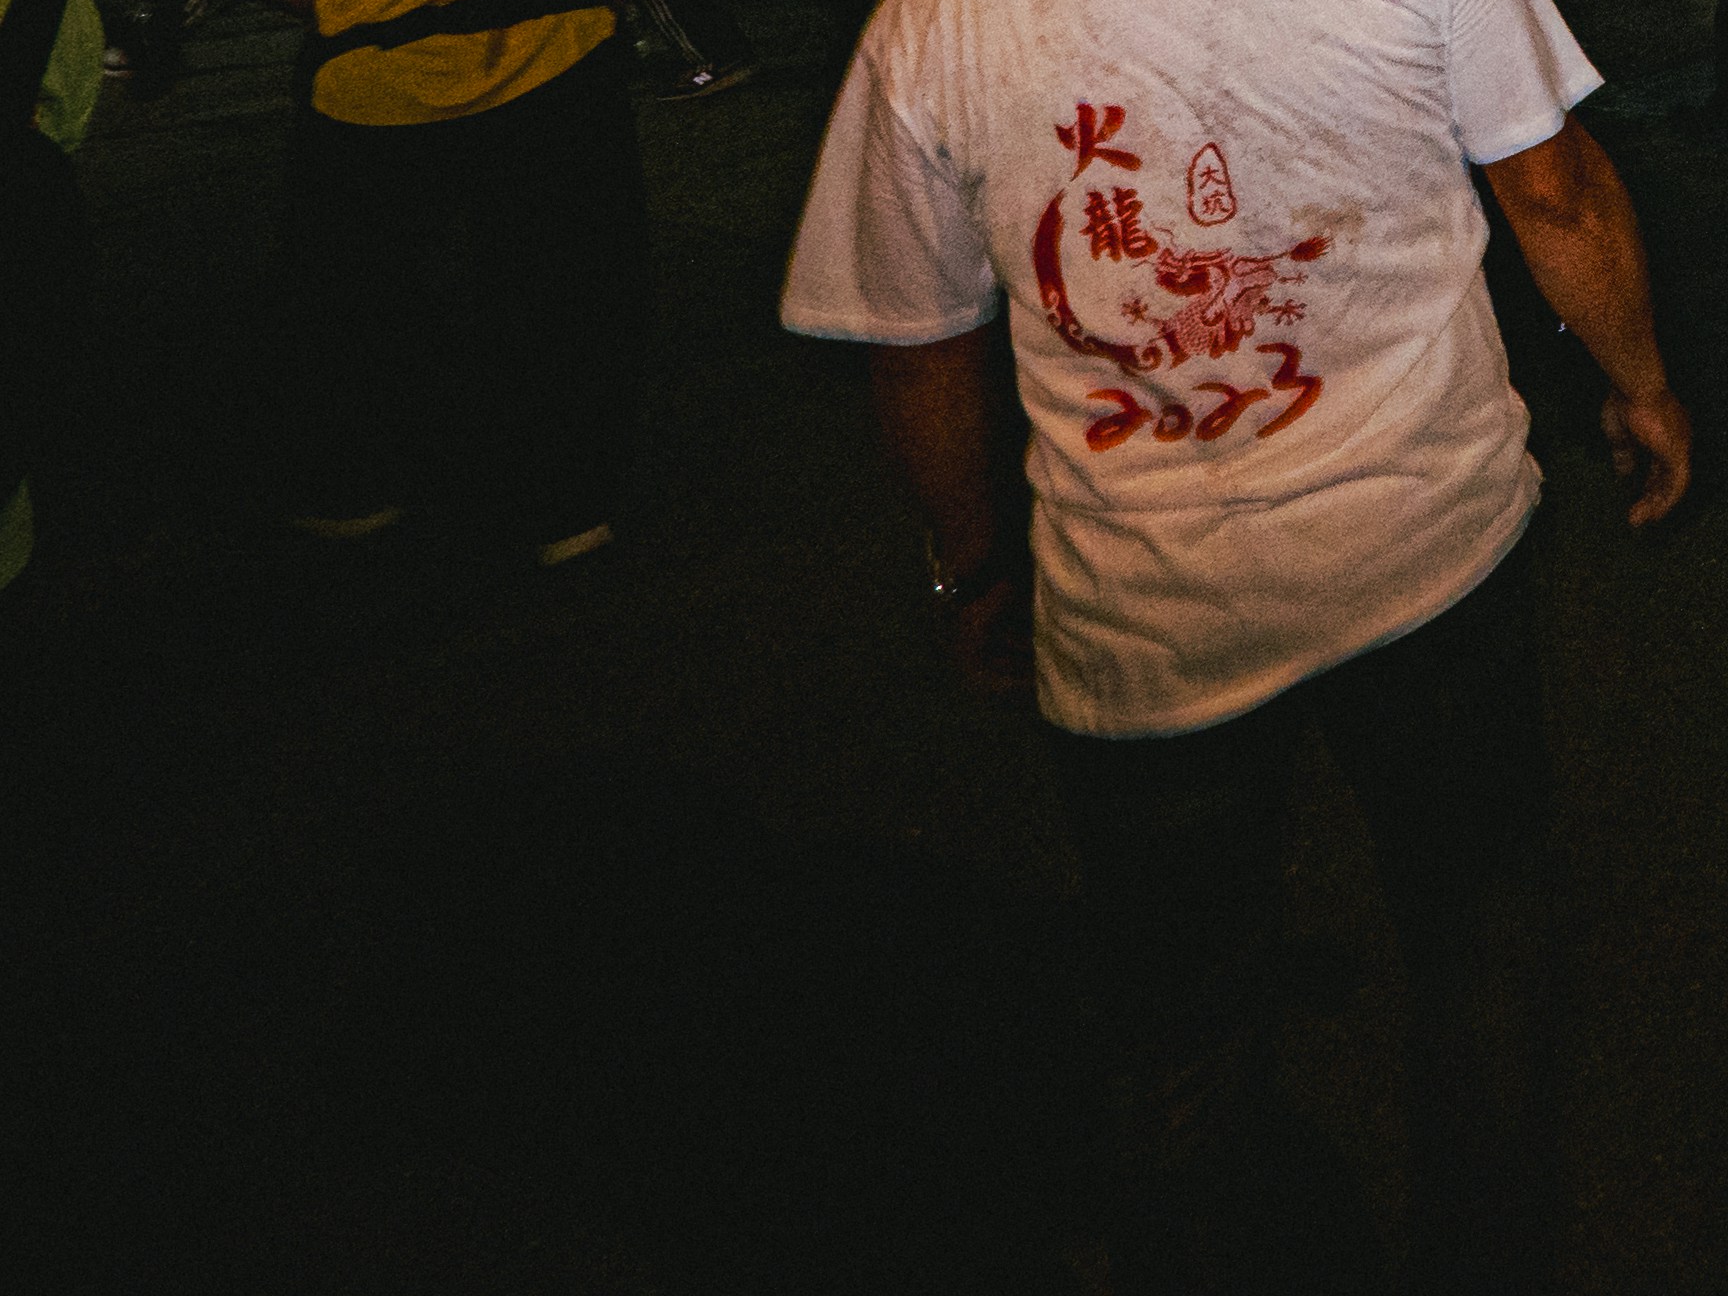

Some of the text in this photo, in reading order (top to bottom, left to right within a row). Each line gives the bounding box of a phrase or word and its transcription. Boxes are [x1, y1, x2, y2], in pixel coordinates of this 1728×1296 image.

[1055, 100, 1158, 262] 火龍
[1197, 164, 1232, 214] 大坑
[1085, 342, 1325, 453] 2023
